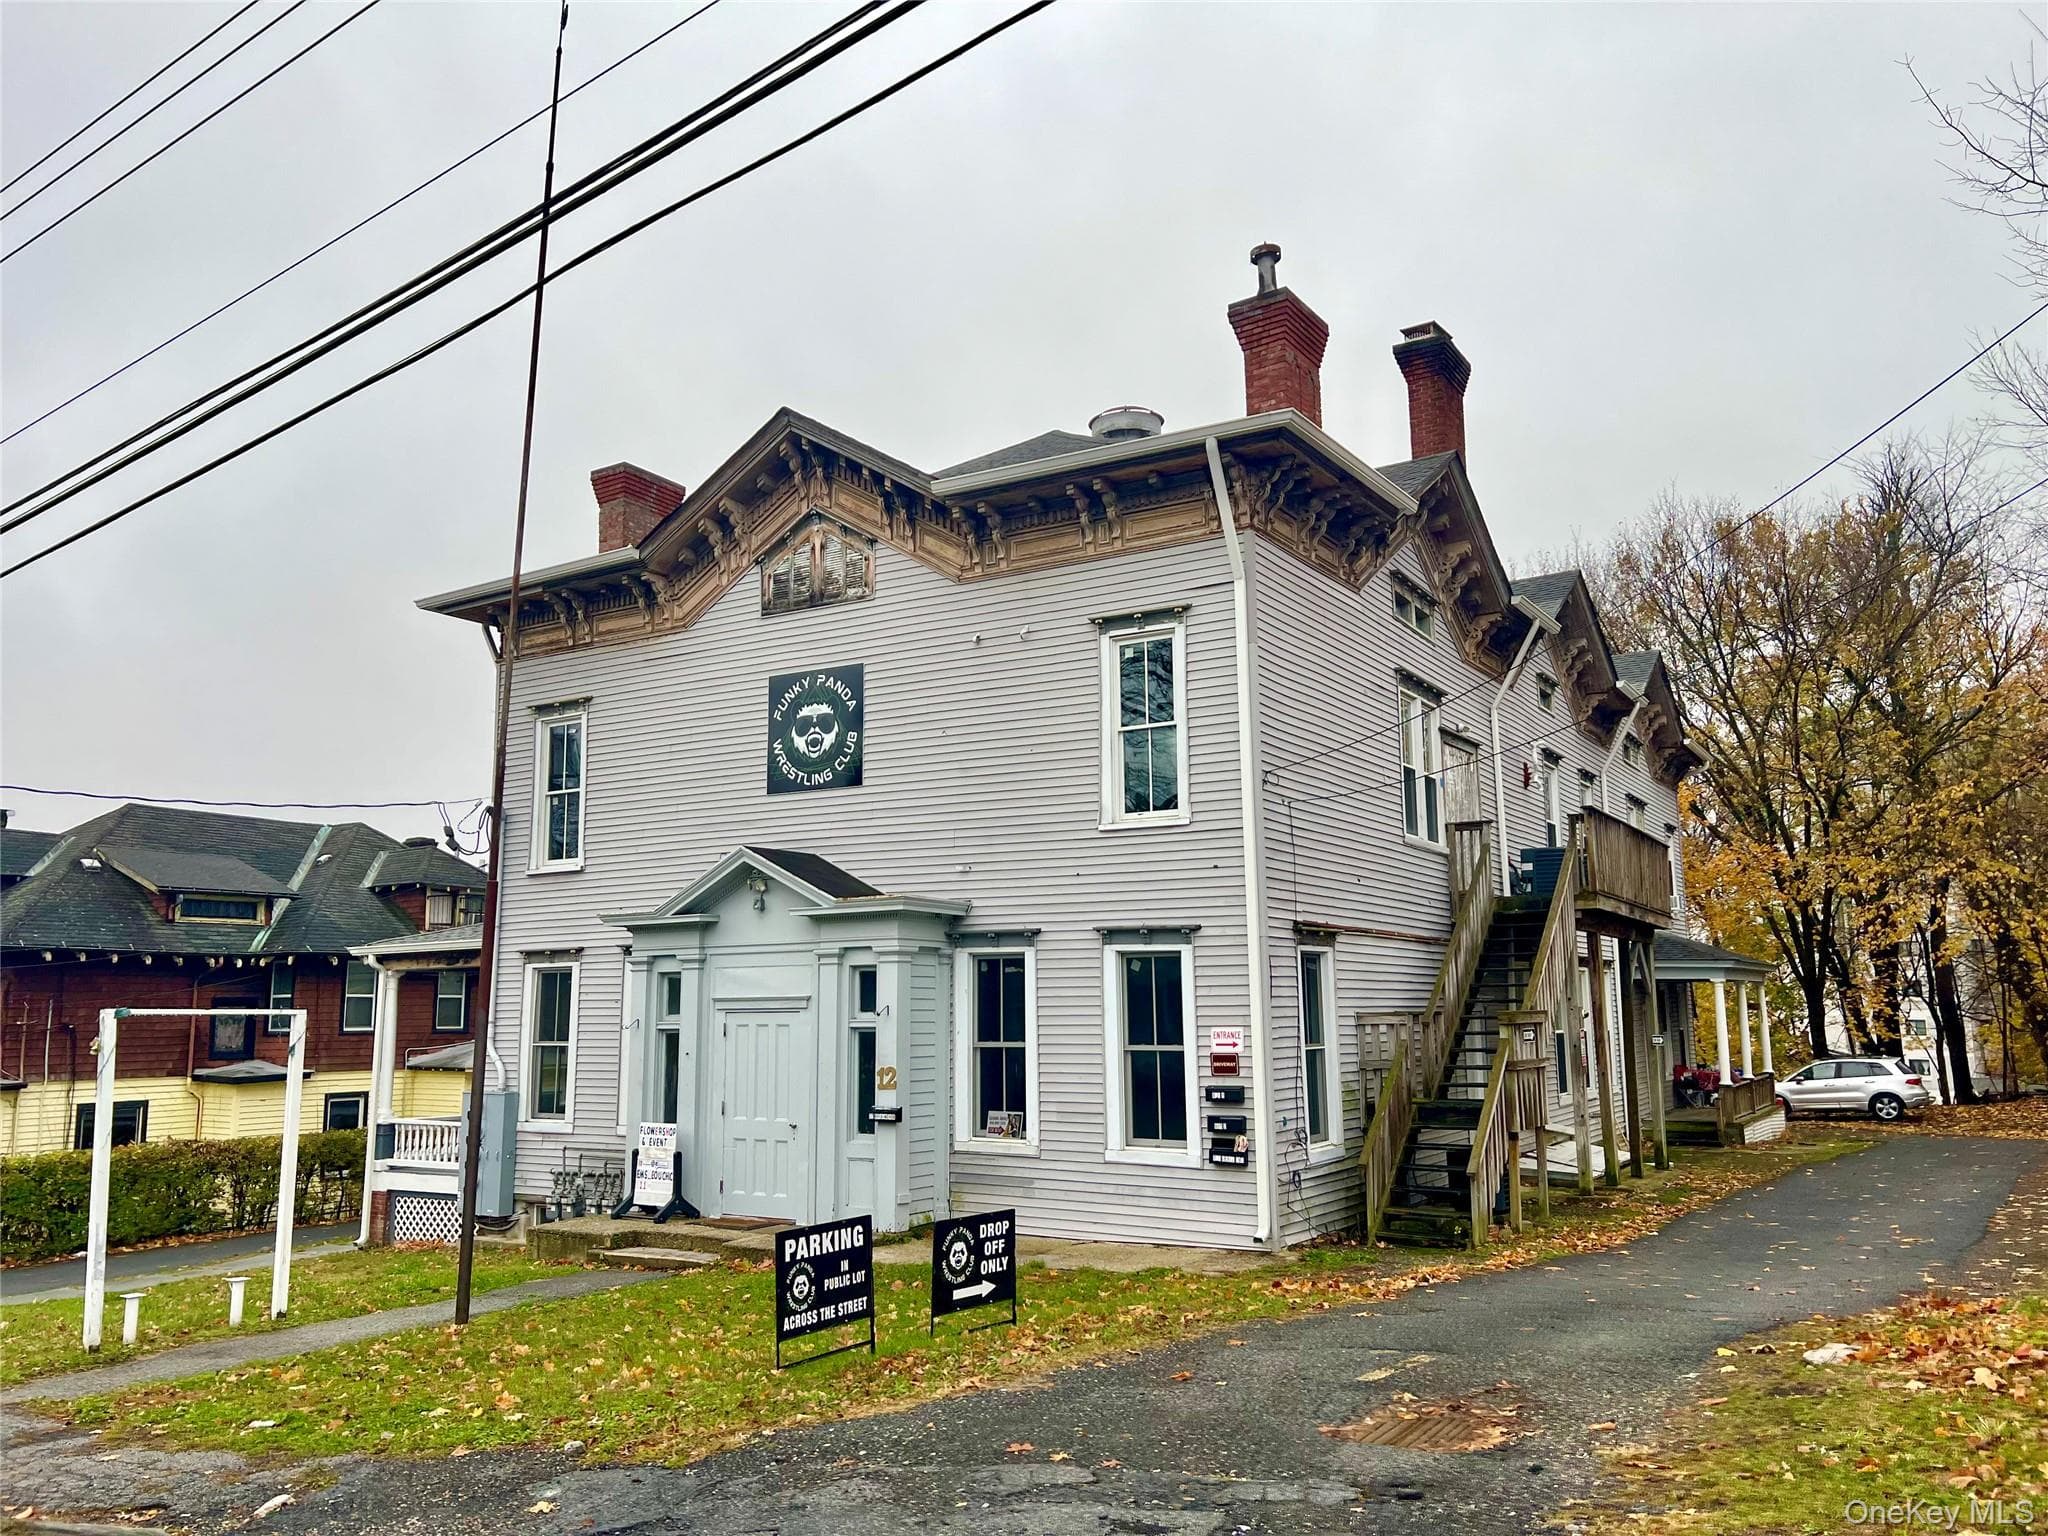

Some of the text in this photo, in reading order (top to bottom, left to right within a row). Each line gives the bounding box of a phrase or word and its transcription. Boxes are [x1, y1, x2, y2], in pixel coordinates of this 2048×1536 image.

[773, 674, 857, 721] FUNKY PANDA
[773, 731, 858, 786] WRESTLING CLUB
[1213, 1030, 1242, 1040] ENTRANCE
[876, 1066, 897, 1090] 12
[639, 1125, 676, 1137] FLOWERSHOP
[648, 1137, 668, 1147] EVENT
[941, 1226, 975, 1251] FUNKY PANDA
[979, 1220, 1010, 1239] DROP
[784, 1224, 864, 1262] PARKING
[983, 1239, 1006, 1257] OFF
[786, 1261, 815, 1284] FUNKY PANDA
[840, 1259, 849, 1273] IN
[941, 1255, 975, 1284] WRESTLING CLUB
[980, 1256, 1009, 1276] ONLY
[824, 1270, 866, 1292] PUBLIC LOT
[786, 1285, 816, 1312] WRESTLING CLUB
[783, 1296, 868, 1332] ACROSS THE STREET
